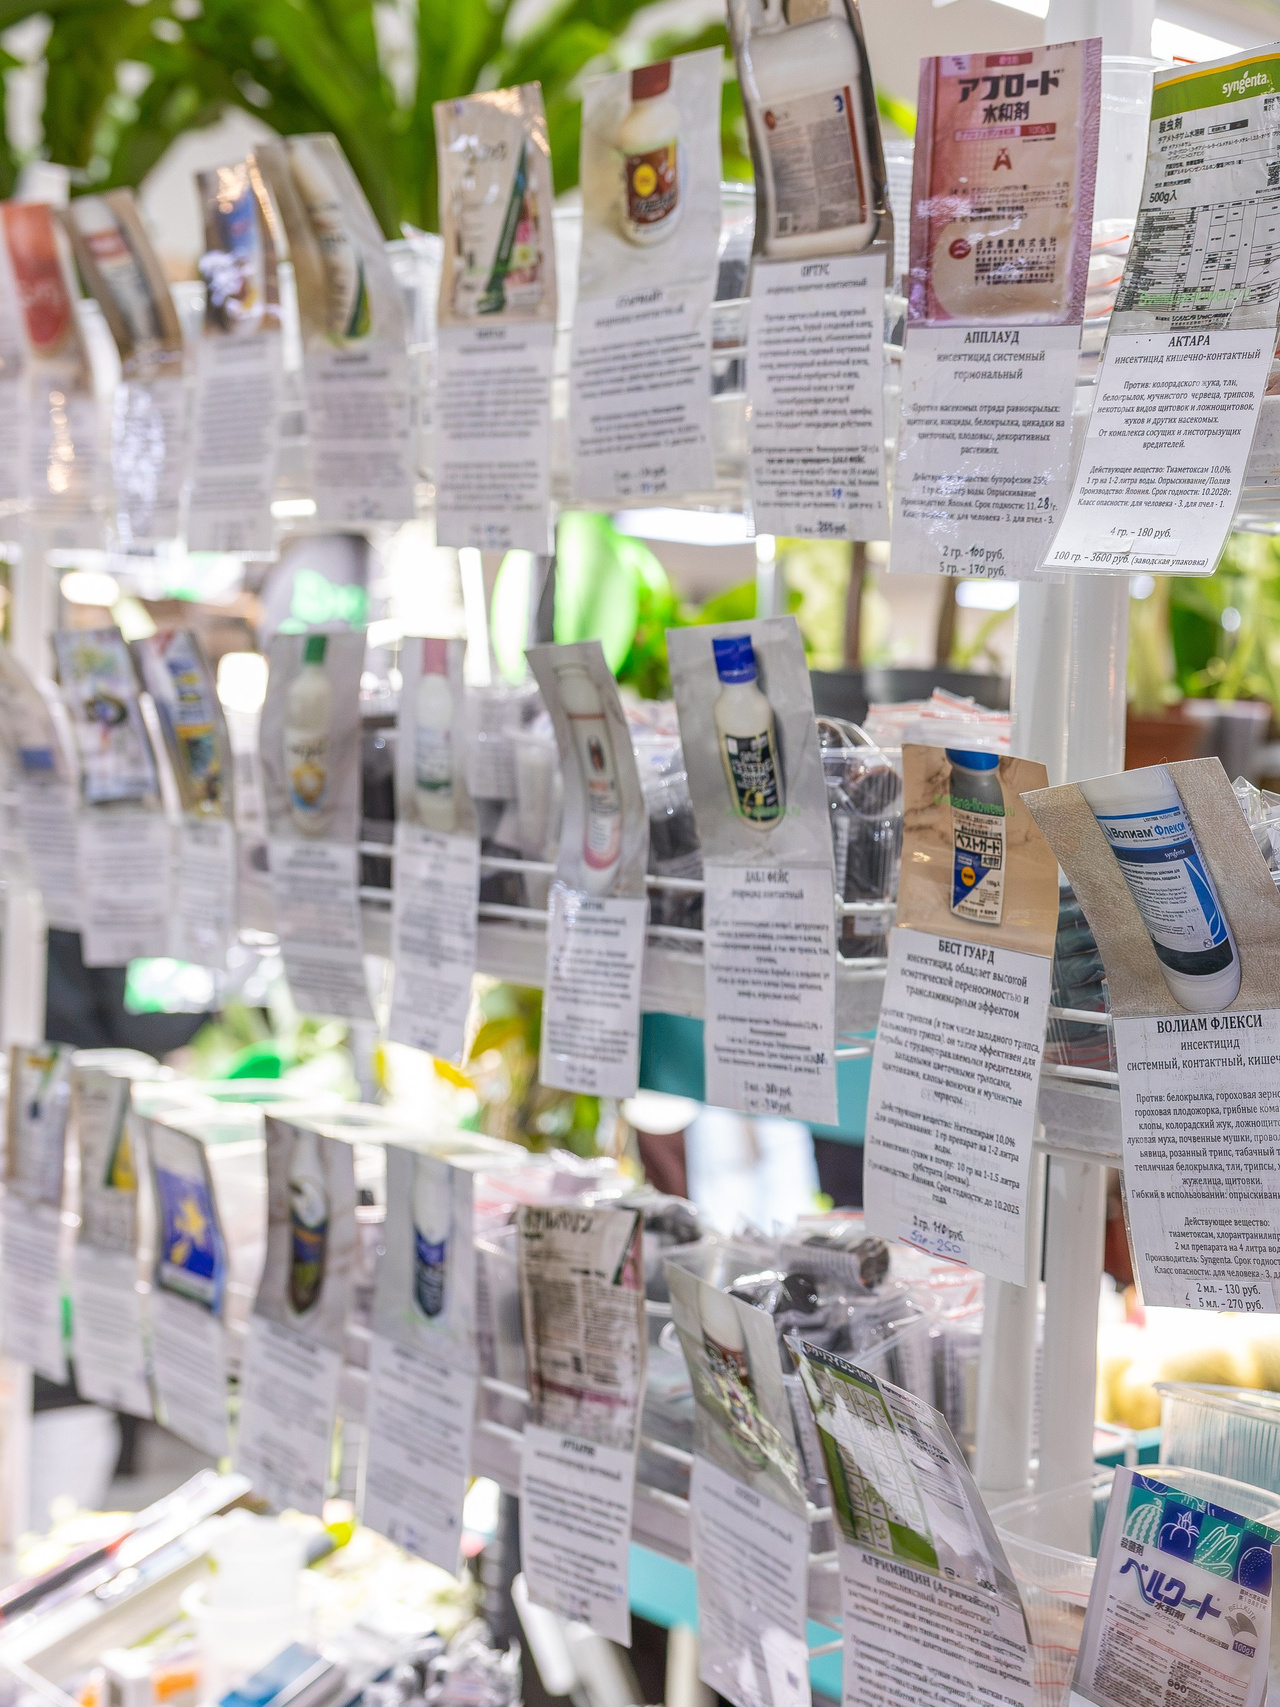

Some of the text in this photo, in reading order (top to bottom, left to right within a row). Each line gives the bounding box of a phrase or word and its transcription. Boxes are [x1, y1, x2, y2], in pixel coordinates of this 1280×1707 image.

[1222, 72, 1268, 97] syngenta
[1158, 117, 1183, 134] 殺虫剤
[963, 330, 1020, 344] АППЛАУД
[1167, 334, 1213, 347] АКТАРА
[1109, 526, 1116, 535] 4
[1115, 528, 1129, 538] гр.
[1136, 527, 1154, 537] 180
[1152, 527, 1173, 540] руб.
[937, 939, 995, 964] БЕСТ ГУАРД
[1156, 1013, 1262, 1033] ВОЛИАМ ФЛЕКСИ
[1179, 1038, 1240, 1052] инсектицид
[1125, 1056, 1180, 1071] системный,
[1181, 1053, 1246, 1069] контактный,
[1157, 1135, 1178, 1145] муха,
[1178, 1135, 1222, 1143] почвенные
[1222, 1134, 1253, 1144] мушки,
[1168, 1230, 1216, 1239] тиаметоксам,
[1199, 1254, 1233, 1266] Syngenta.
[1232, 1255, 1252, 1266] Срок
[1198, 1297, 1204, 1307] 5
[1205, 1299, 1220, 1308] мл.
[1226, 1297, 1244, 1311] 270
[1244, 1298, 1264, 1313] руб.
[1119, 1557, 1222, 1621] ベルクート
[1154, 1601, 1187, 1622] 水和剤
